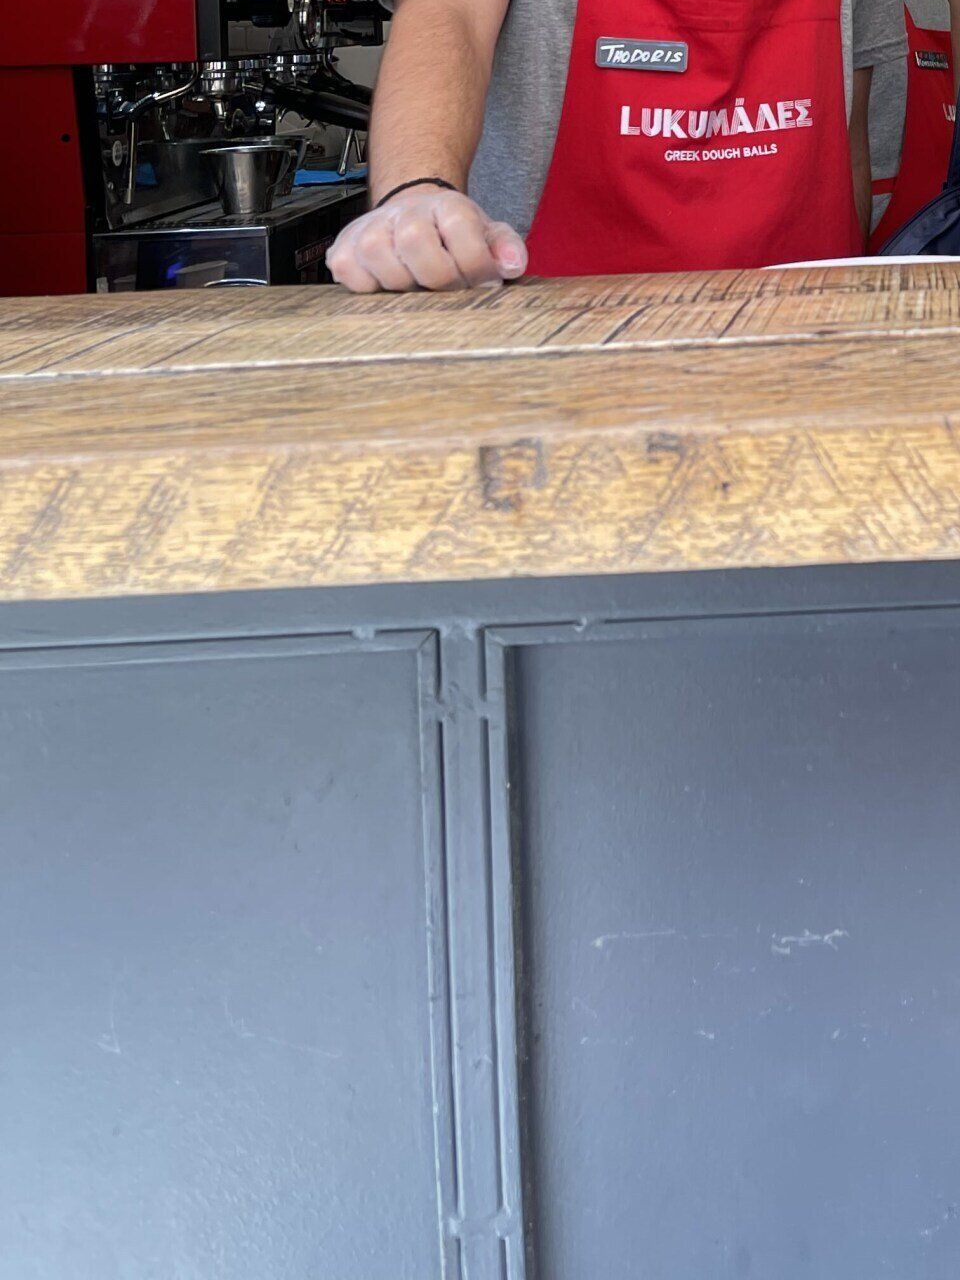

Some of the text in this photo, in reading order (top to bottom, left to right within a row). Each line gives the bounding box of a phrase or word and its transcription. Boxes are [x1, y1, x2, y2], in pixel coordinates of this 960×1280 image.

[664, 143, 778, 162] GREEK DOUGH BALLS
